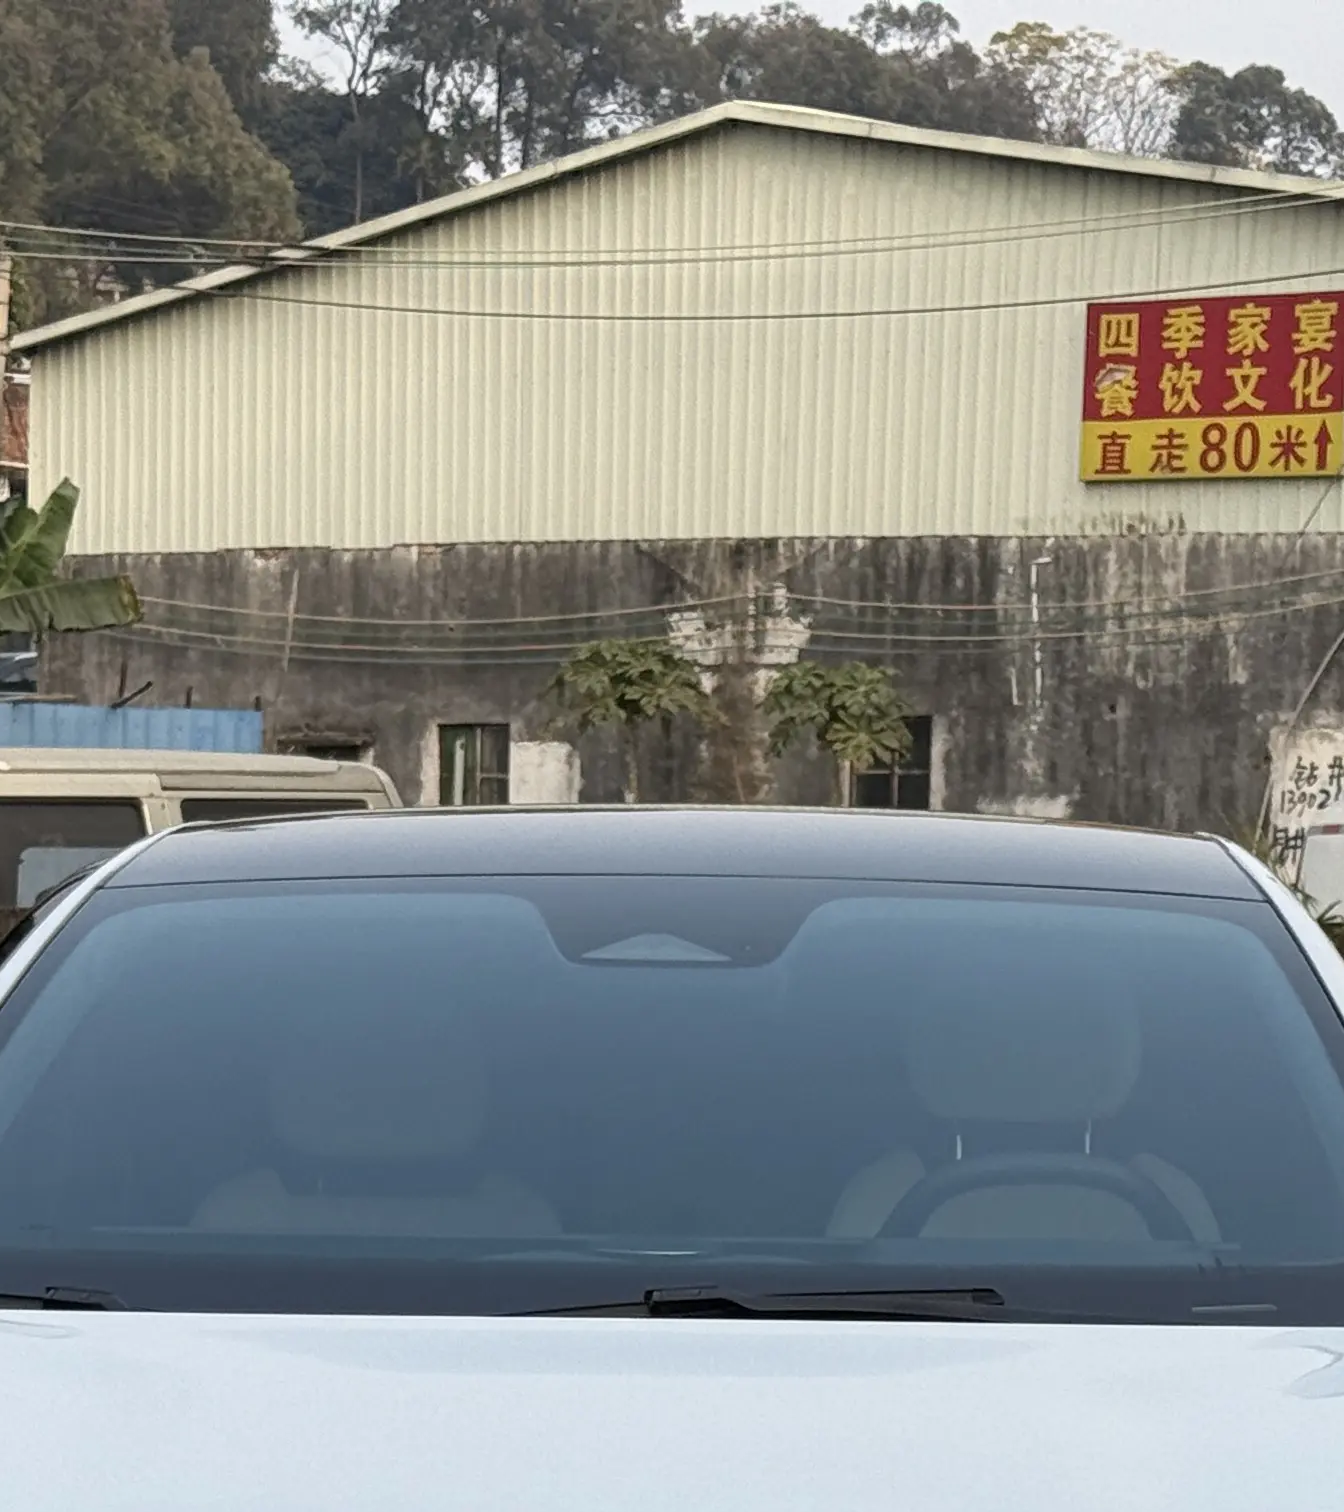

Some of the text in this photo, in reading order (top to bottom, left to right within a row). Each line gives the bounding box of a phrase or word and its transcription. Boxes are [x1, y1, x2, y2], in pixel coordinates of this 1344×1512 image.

[1098, 299, 1339, 358] 四季家宴
[1094, 355, 1334, 418] 餐饮文化
[1094, 421, 1308, 476] 直走80米
